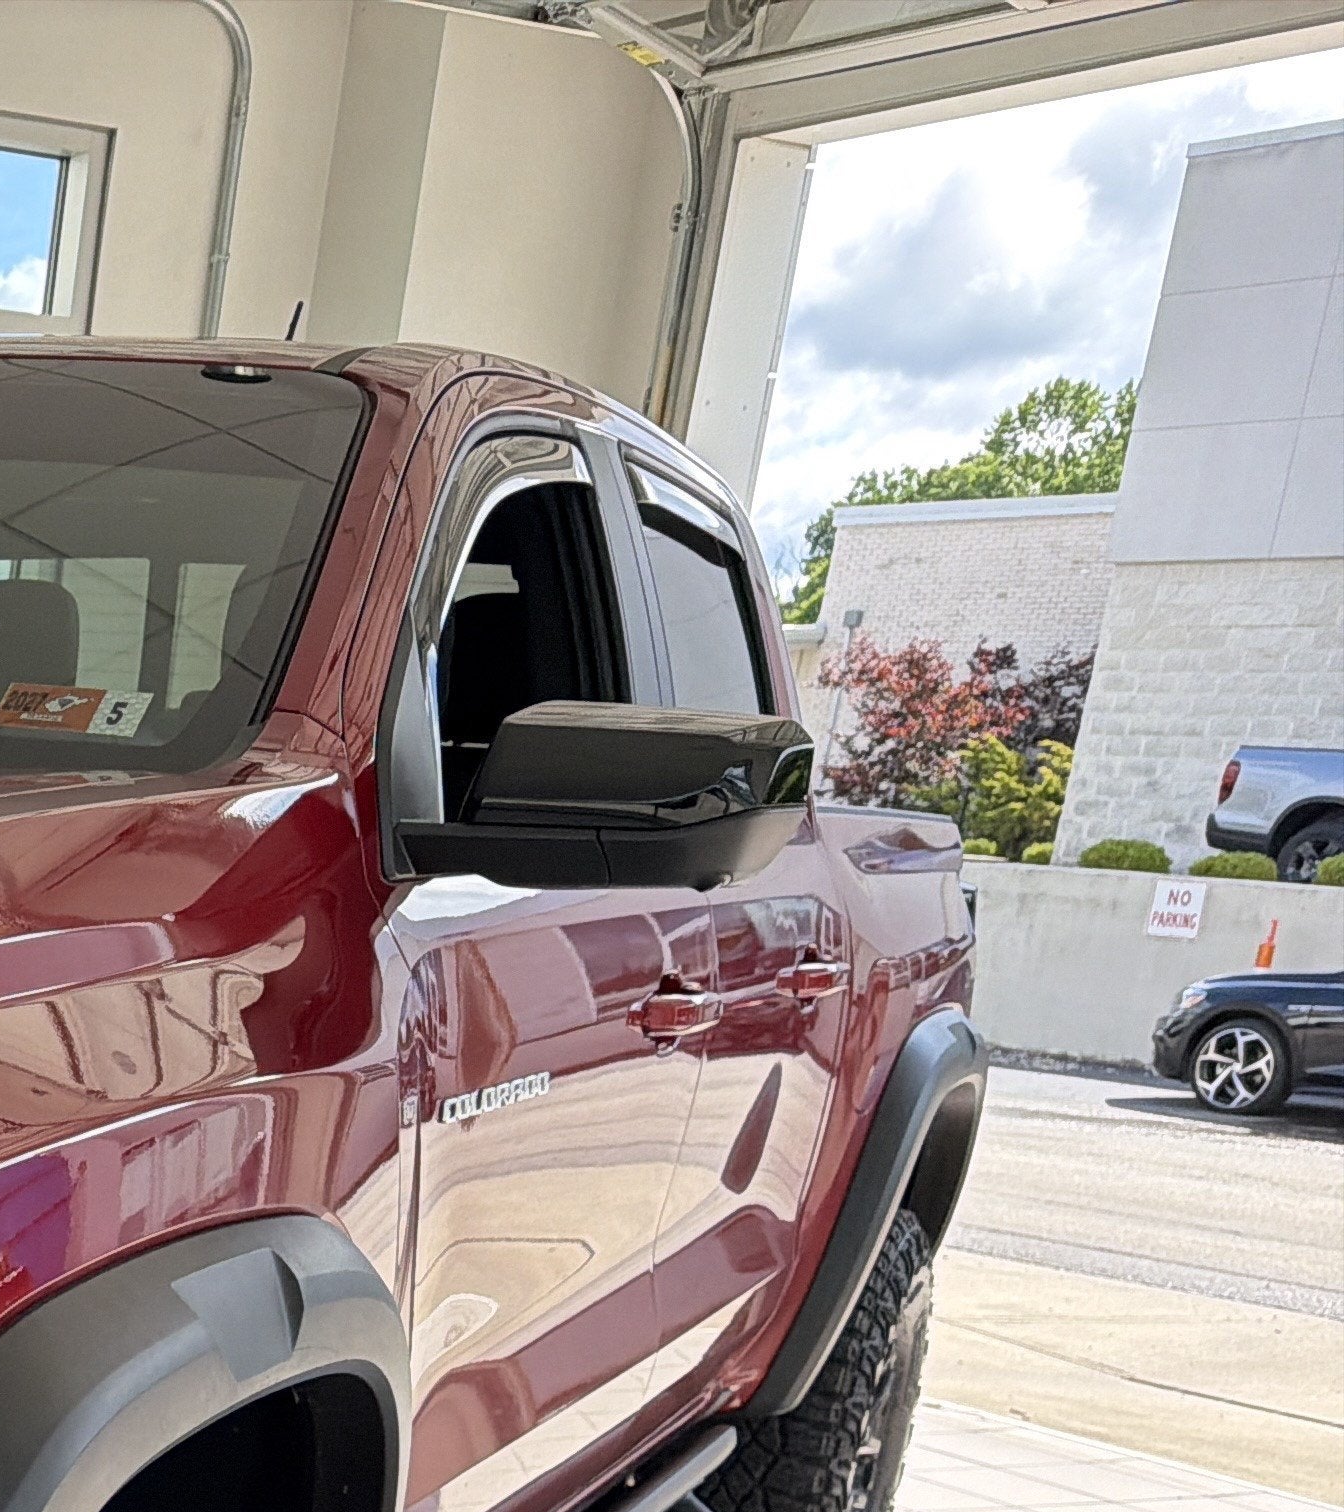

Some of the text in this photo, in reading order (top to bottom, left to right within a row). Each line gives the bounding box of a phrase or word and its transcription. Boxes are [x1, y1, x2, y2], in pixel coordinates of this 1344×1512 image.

[1, 689, 128, 726] 2027 5
[1167, 889, 1192, 907] NO
[1150, 910, 1198, 930] PARKING
[441, 1071, 551, 1124] COLORADO
